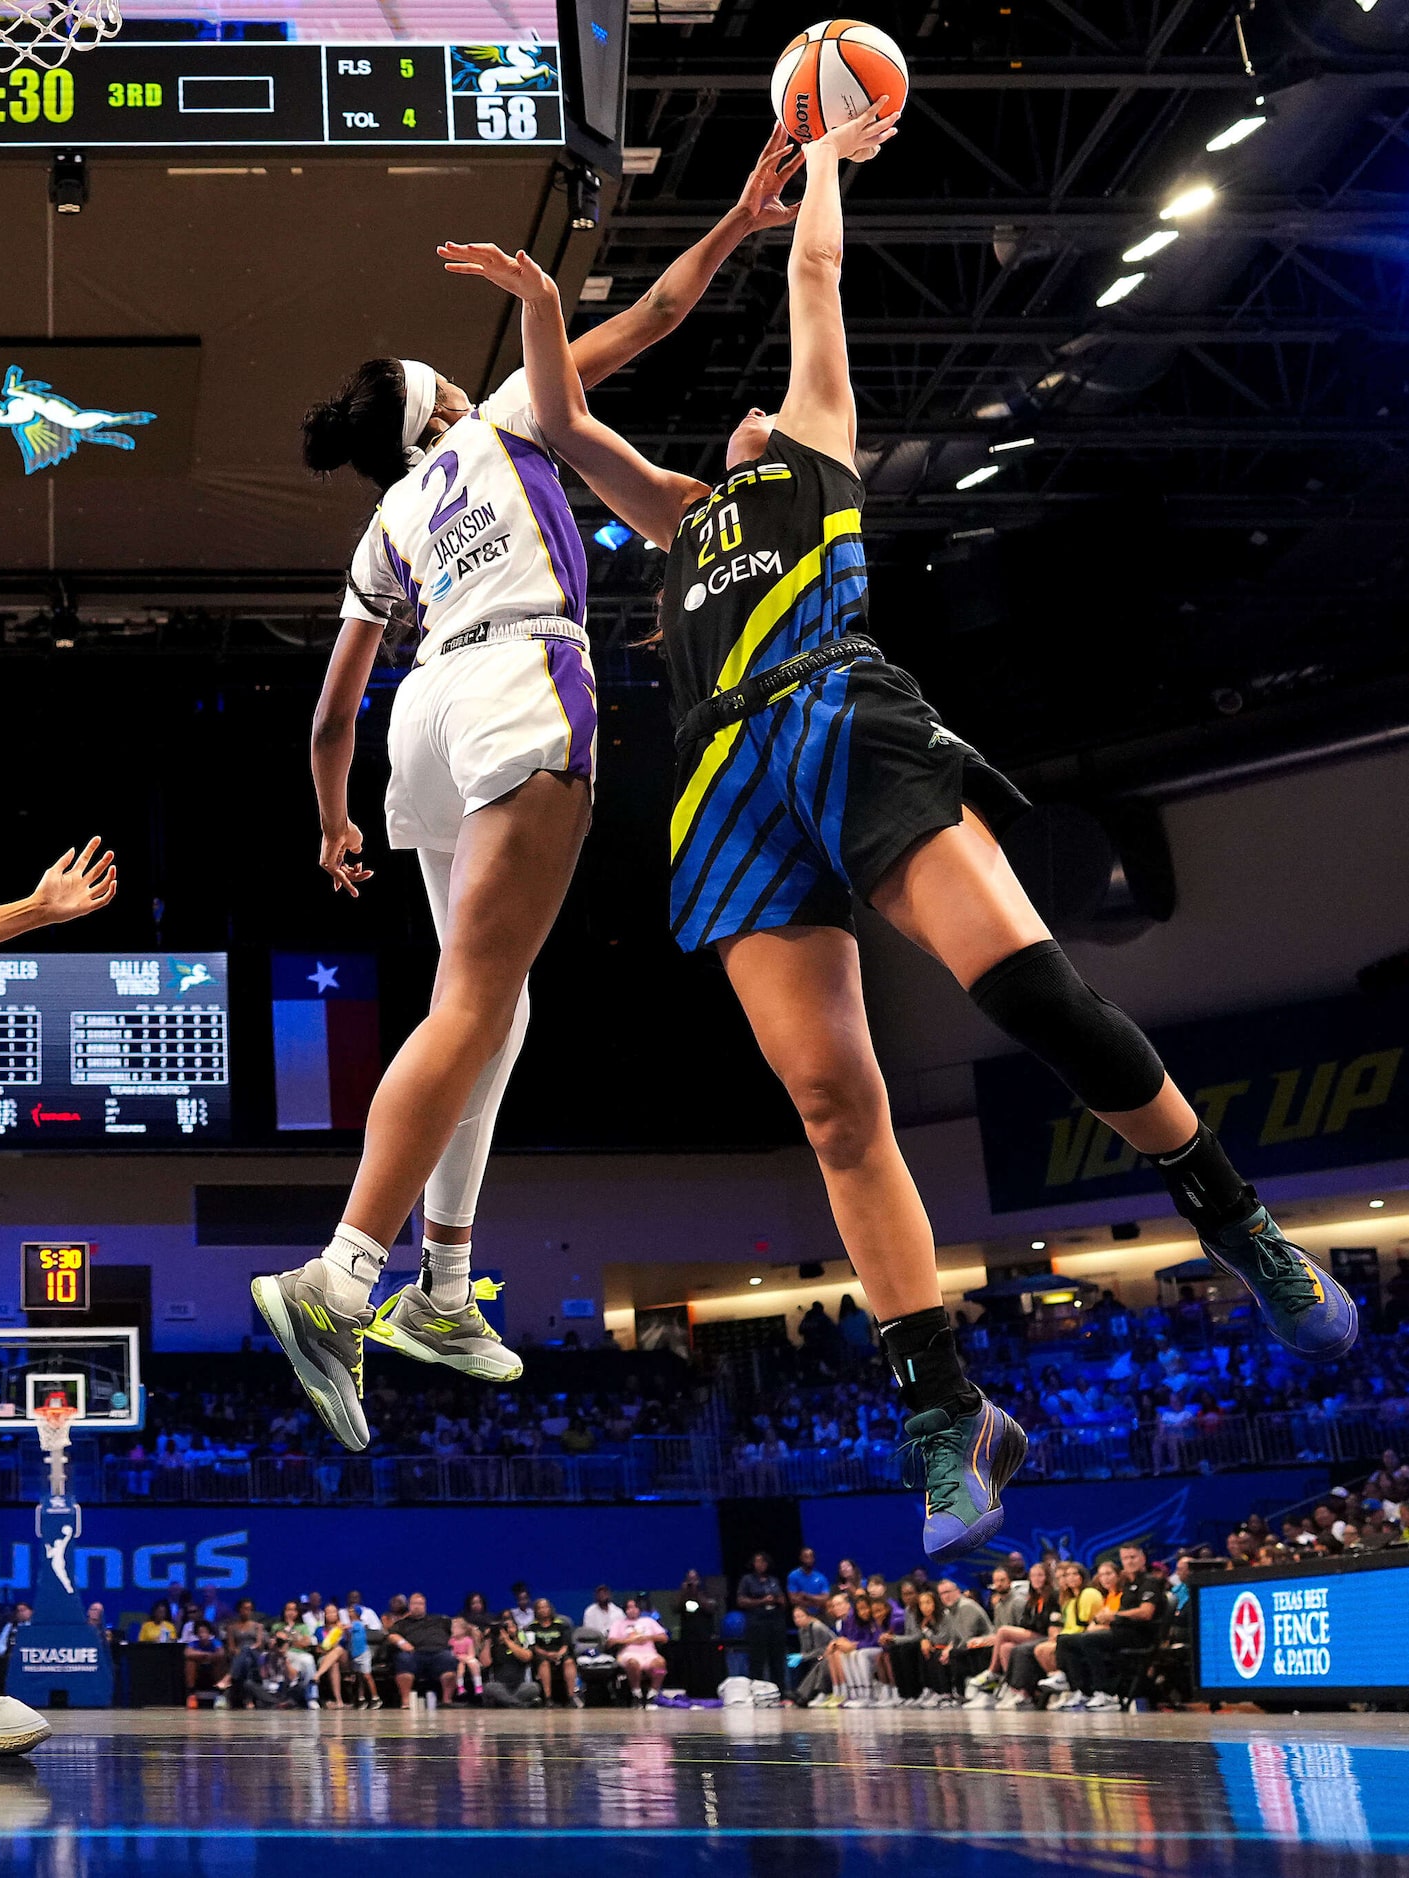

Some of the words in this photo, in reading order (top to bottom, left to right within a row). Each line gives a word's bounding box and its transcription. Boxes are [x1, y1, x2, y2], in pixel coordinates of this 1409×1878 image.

[338, 60, 372, 77] FLS
[399, 59, 415, 79] 5
[108, 82, 163, 108] 3RD
[342, 112, 380, 129] TOL
[402, 108, 417, 129] 4
[476, 96, 538, 141] 58
[421, 449, 469, 535] 2
[434, 501, 498, 571] JACKSON
[697, 501, 743, 570] 20
[454, 533, 513, 581] AT&T
[707, 549, 784, 595] GEM
[109, 960, 160, 979] DALLAS
[1044, 1079, 1250, 1188] VOT
[1258, 1047, 1404, 1147] UP
[39, 1249, 82, 1270] 5:30
[46, 1270, 77, 1303] 10
[1271, 1589, 1304, 1612] TEXAS
[1304, 1587, 1329, 1609] BEST
[1272, 1611, 1331, 1647] FENCE
[1273, 1648, 1286, 1676] &
[1287, 1647, 1331, 1676] PATIO
